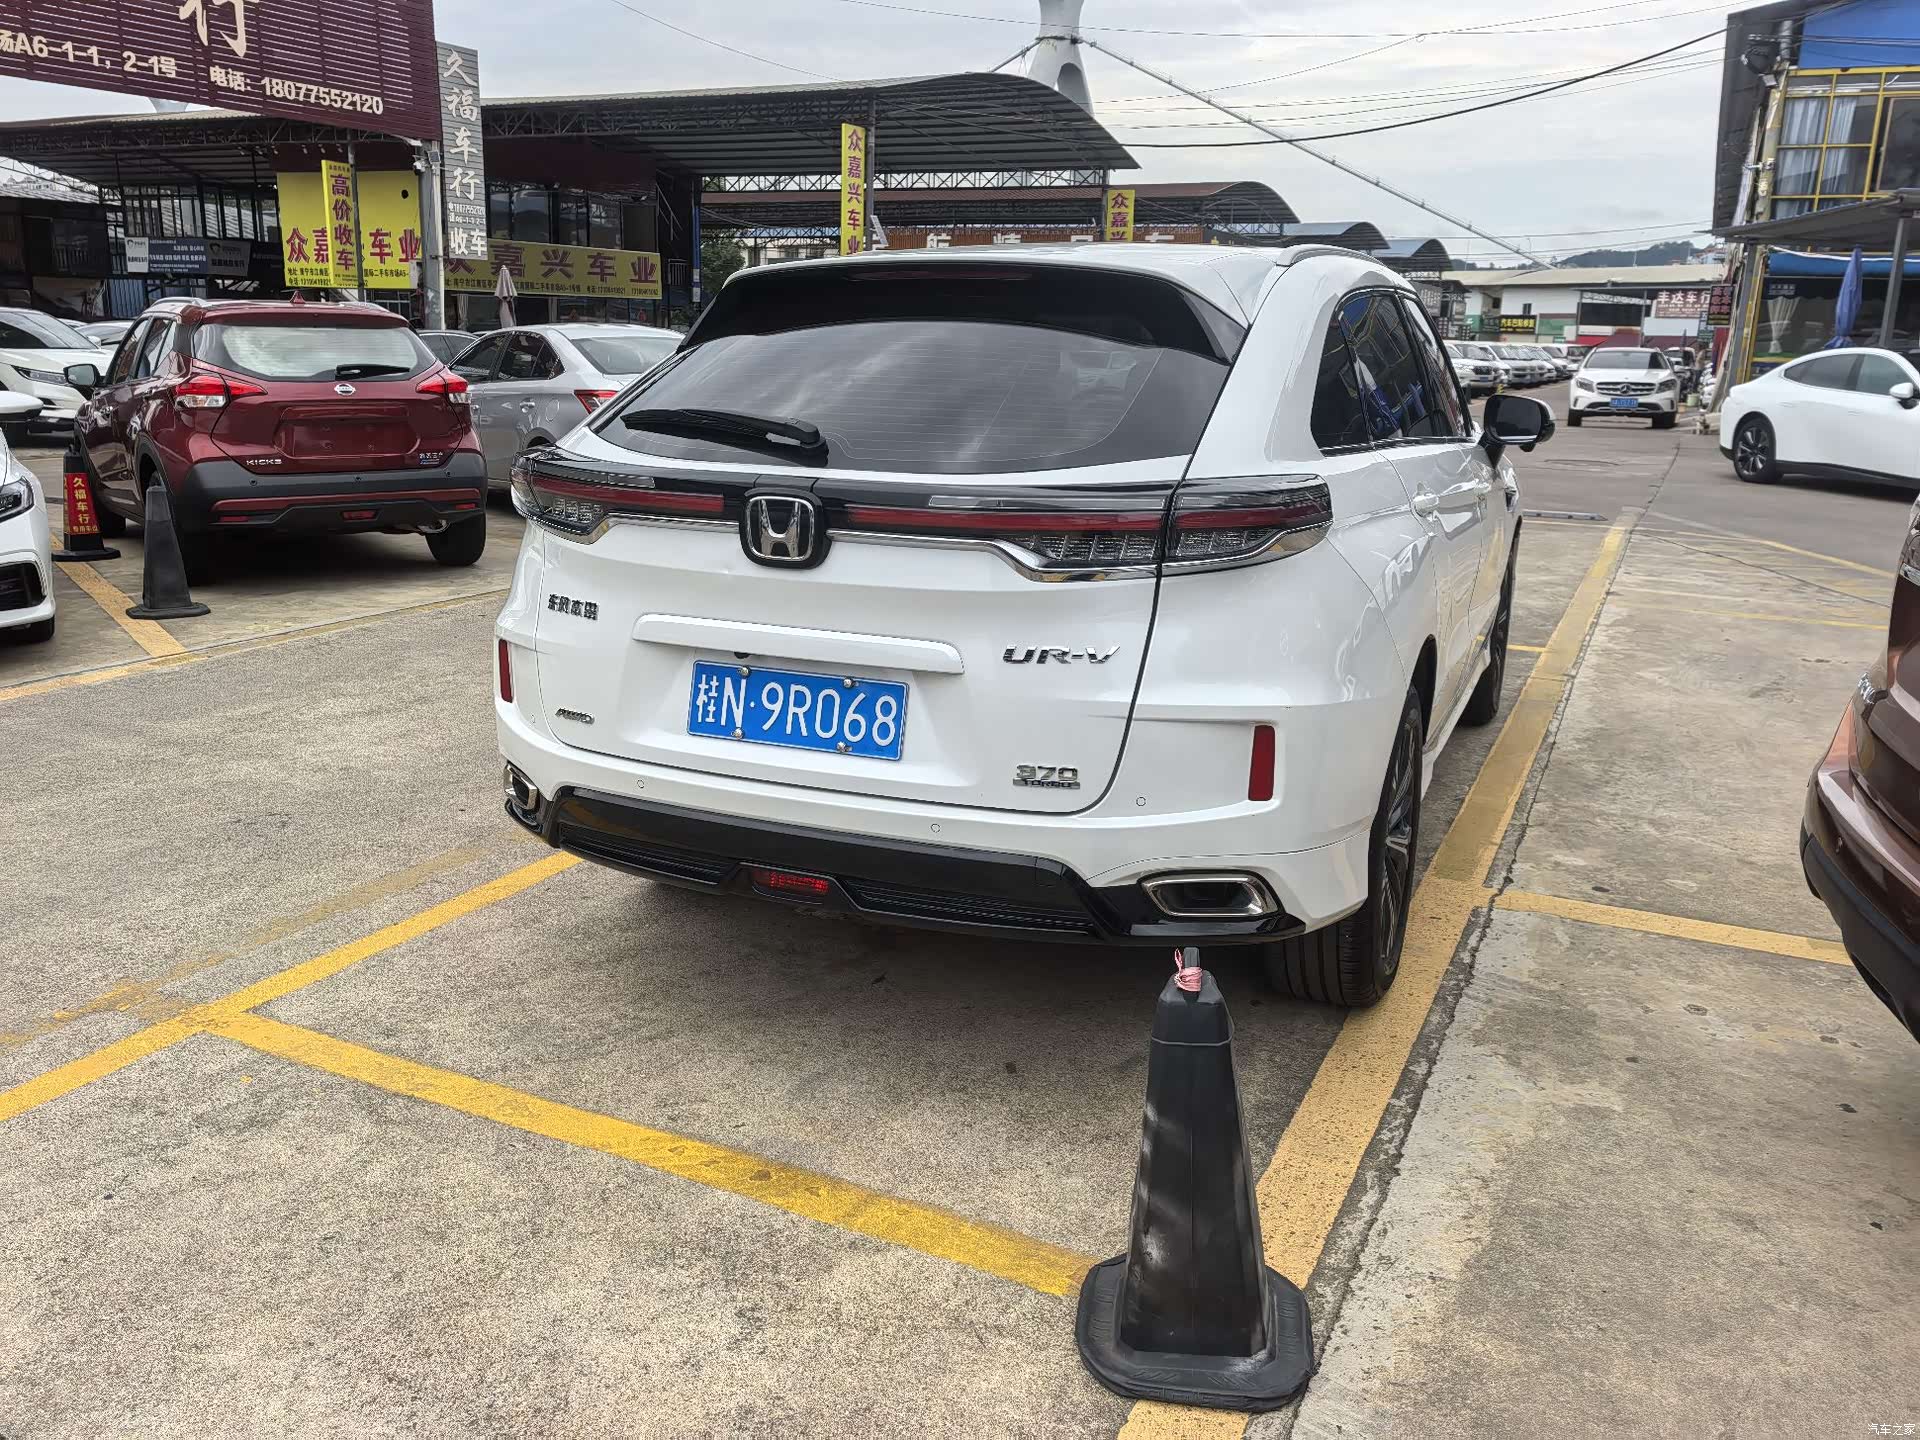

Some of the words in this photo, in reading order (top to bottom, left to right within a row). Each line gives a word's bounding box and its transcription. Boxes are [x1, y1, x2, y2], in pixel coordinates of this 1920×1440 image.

[443, 49, 480, 200] 久福车行
[847, 129, 862, 255] 众嘉兴车业
[330, 173, 355, 271] 高价收车
[450, 227, 487, 257] 收车
[73, 477, 90, 524] 久福车行
[1002, 645, 1121, 664] UR-V
[1016, 765, 1079, 782] 370
